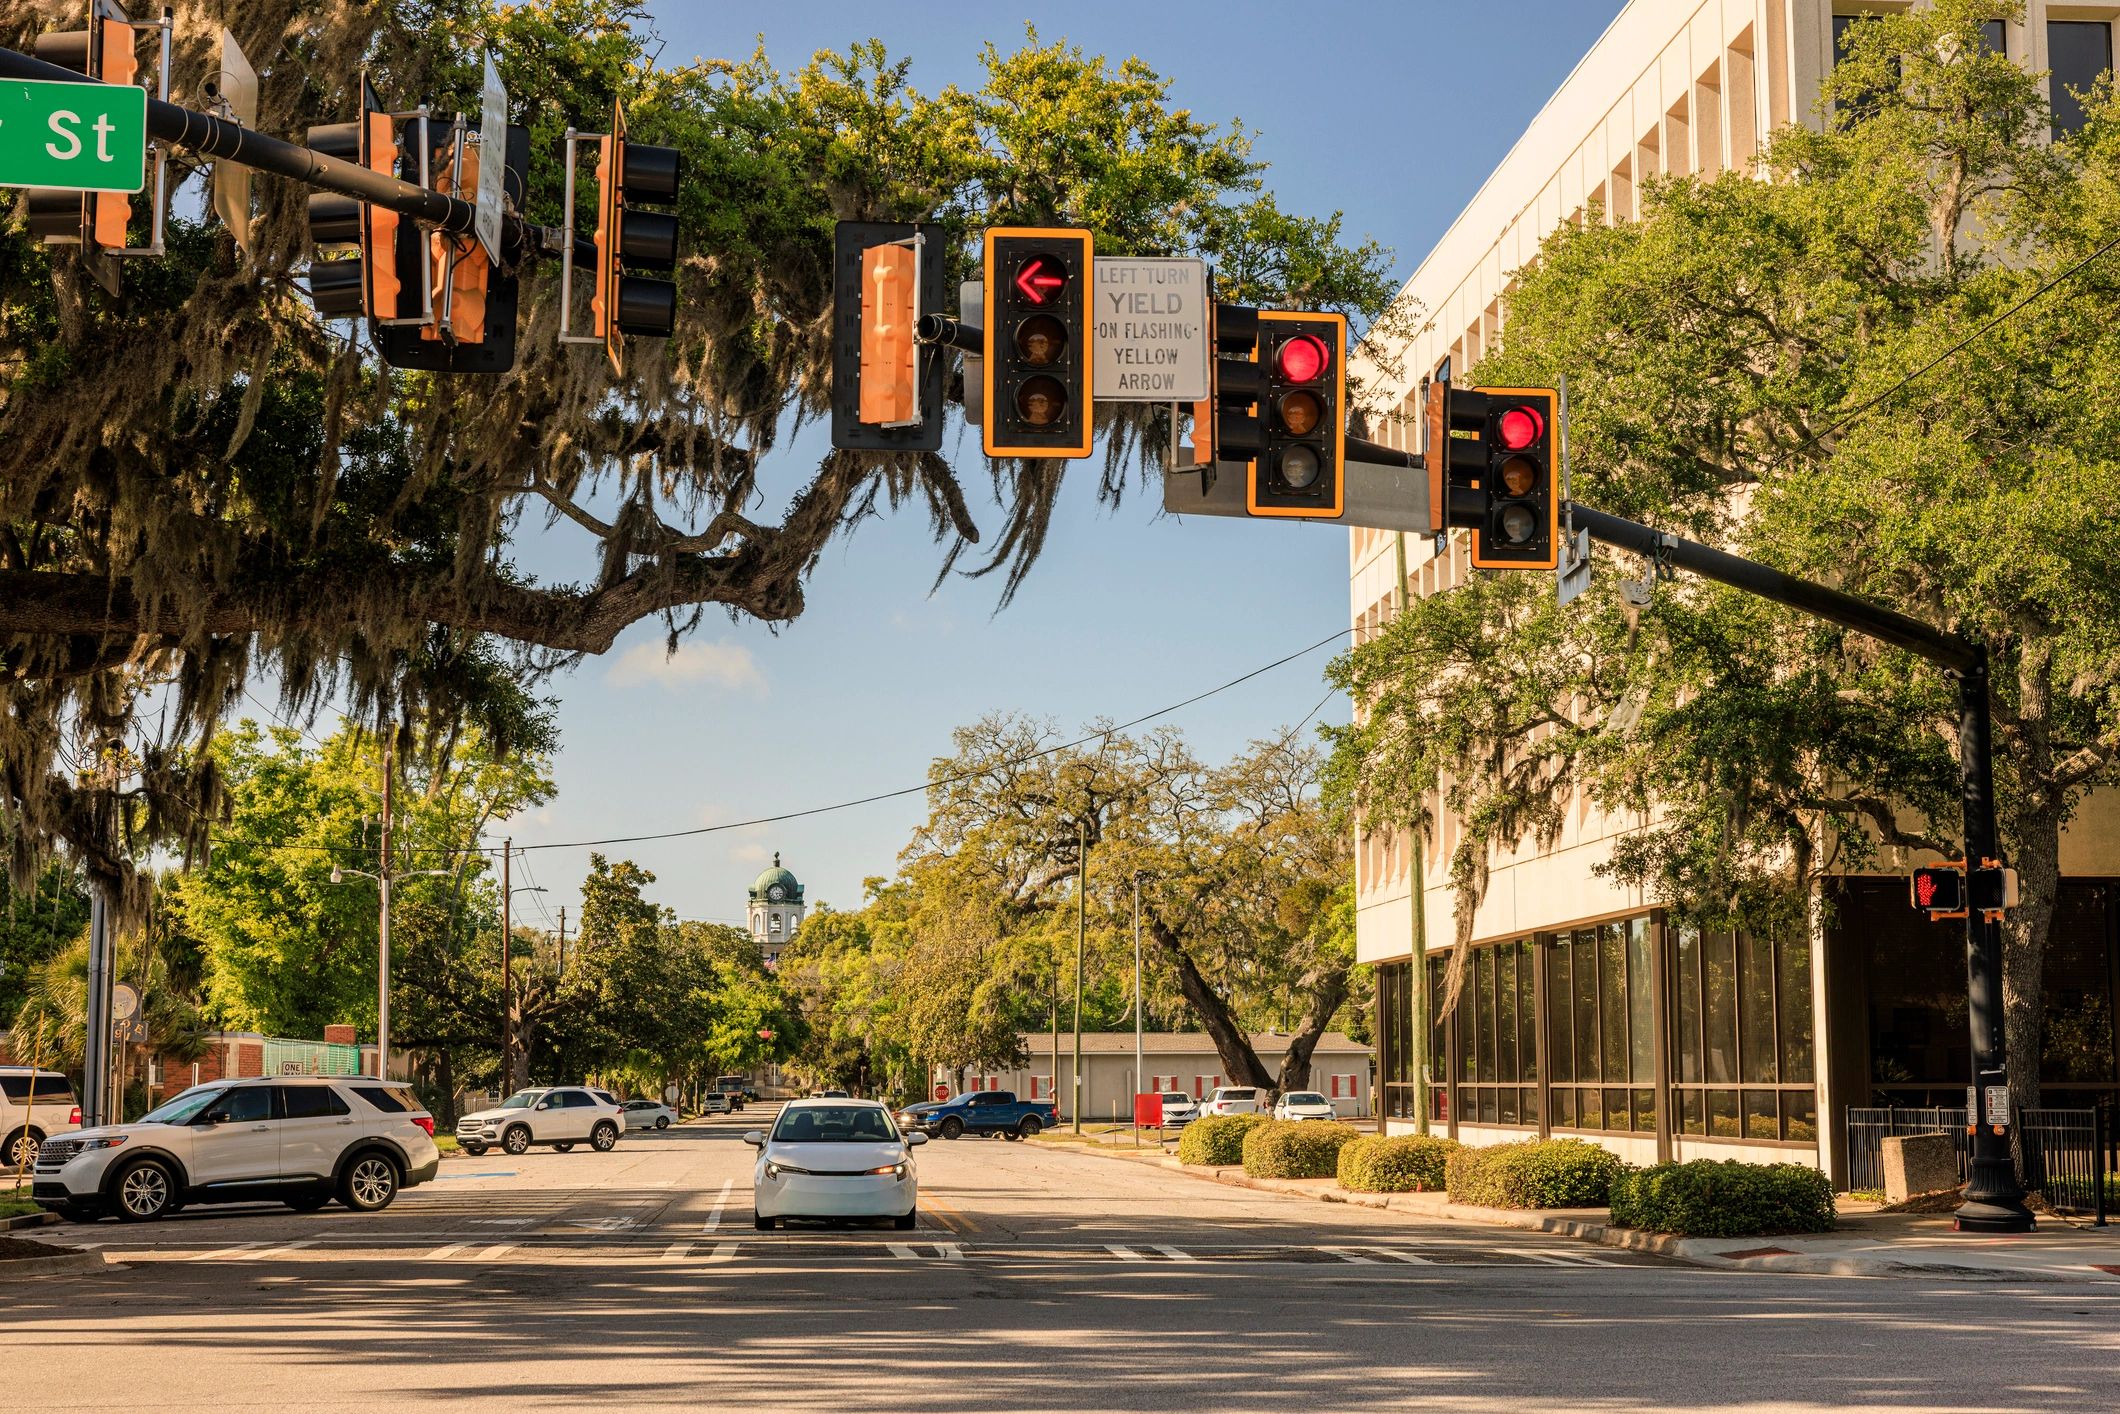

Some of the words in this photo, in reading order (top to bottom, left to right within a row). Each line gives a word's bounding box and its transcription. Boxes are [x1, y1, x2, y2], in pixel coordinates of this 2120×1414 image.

[46, 109, 116, 162] St
[1100, 267, 1138, 284] LEFT
[1146, 268, 1190, 285] TURN
[1108, 292, 1183, 315] YIELD
[1100, 322, 1117, 339] ON
[1125, 322, 1192, 340] FLASHING
[1114, 348, 1178, 365] YELLOW
[1118, 373, 1175, 390] ARROW
[284, 1063, 301, 1072] ONE
